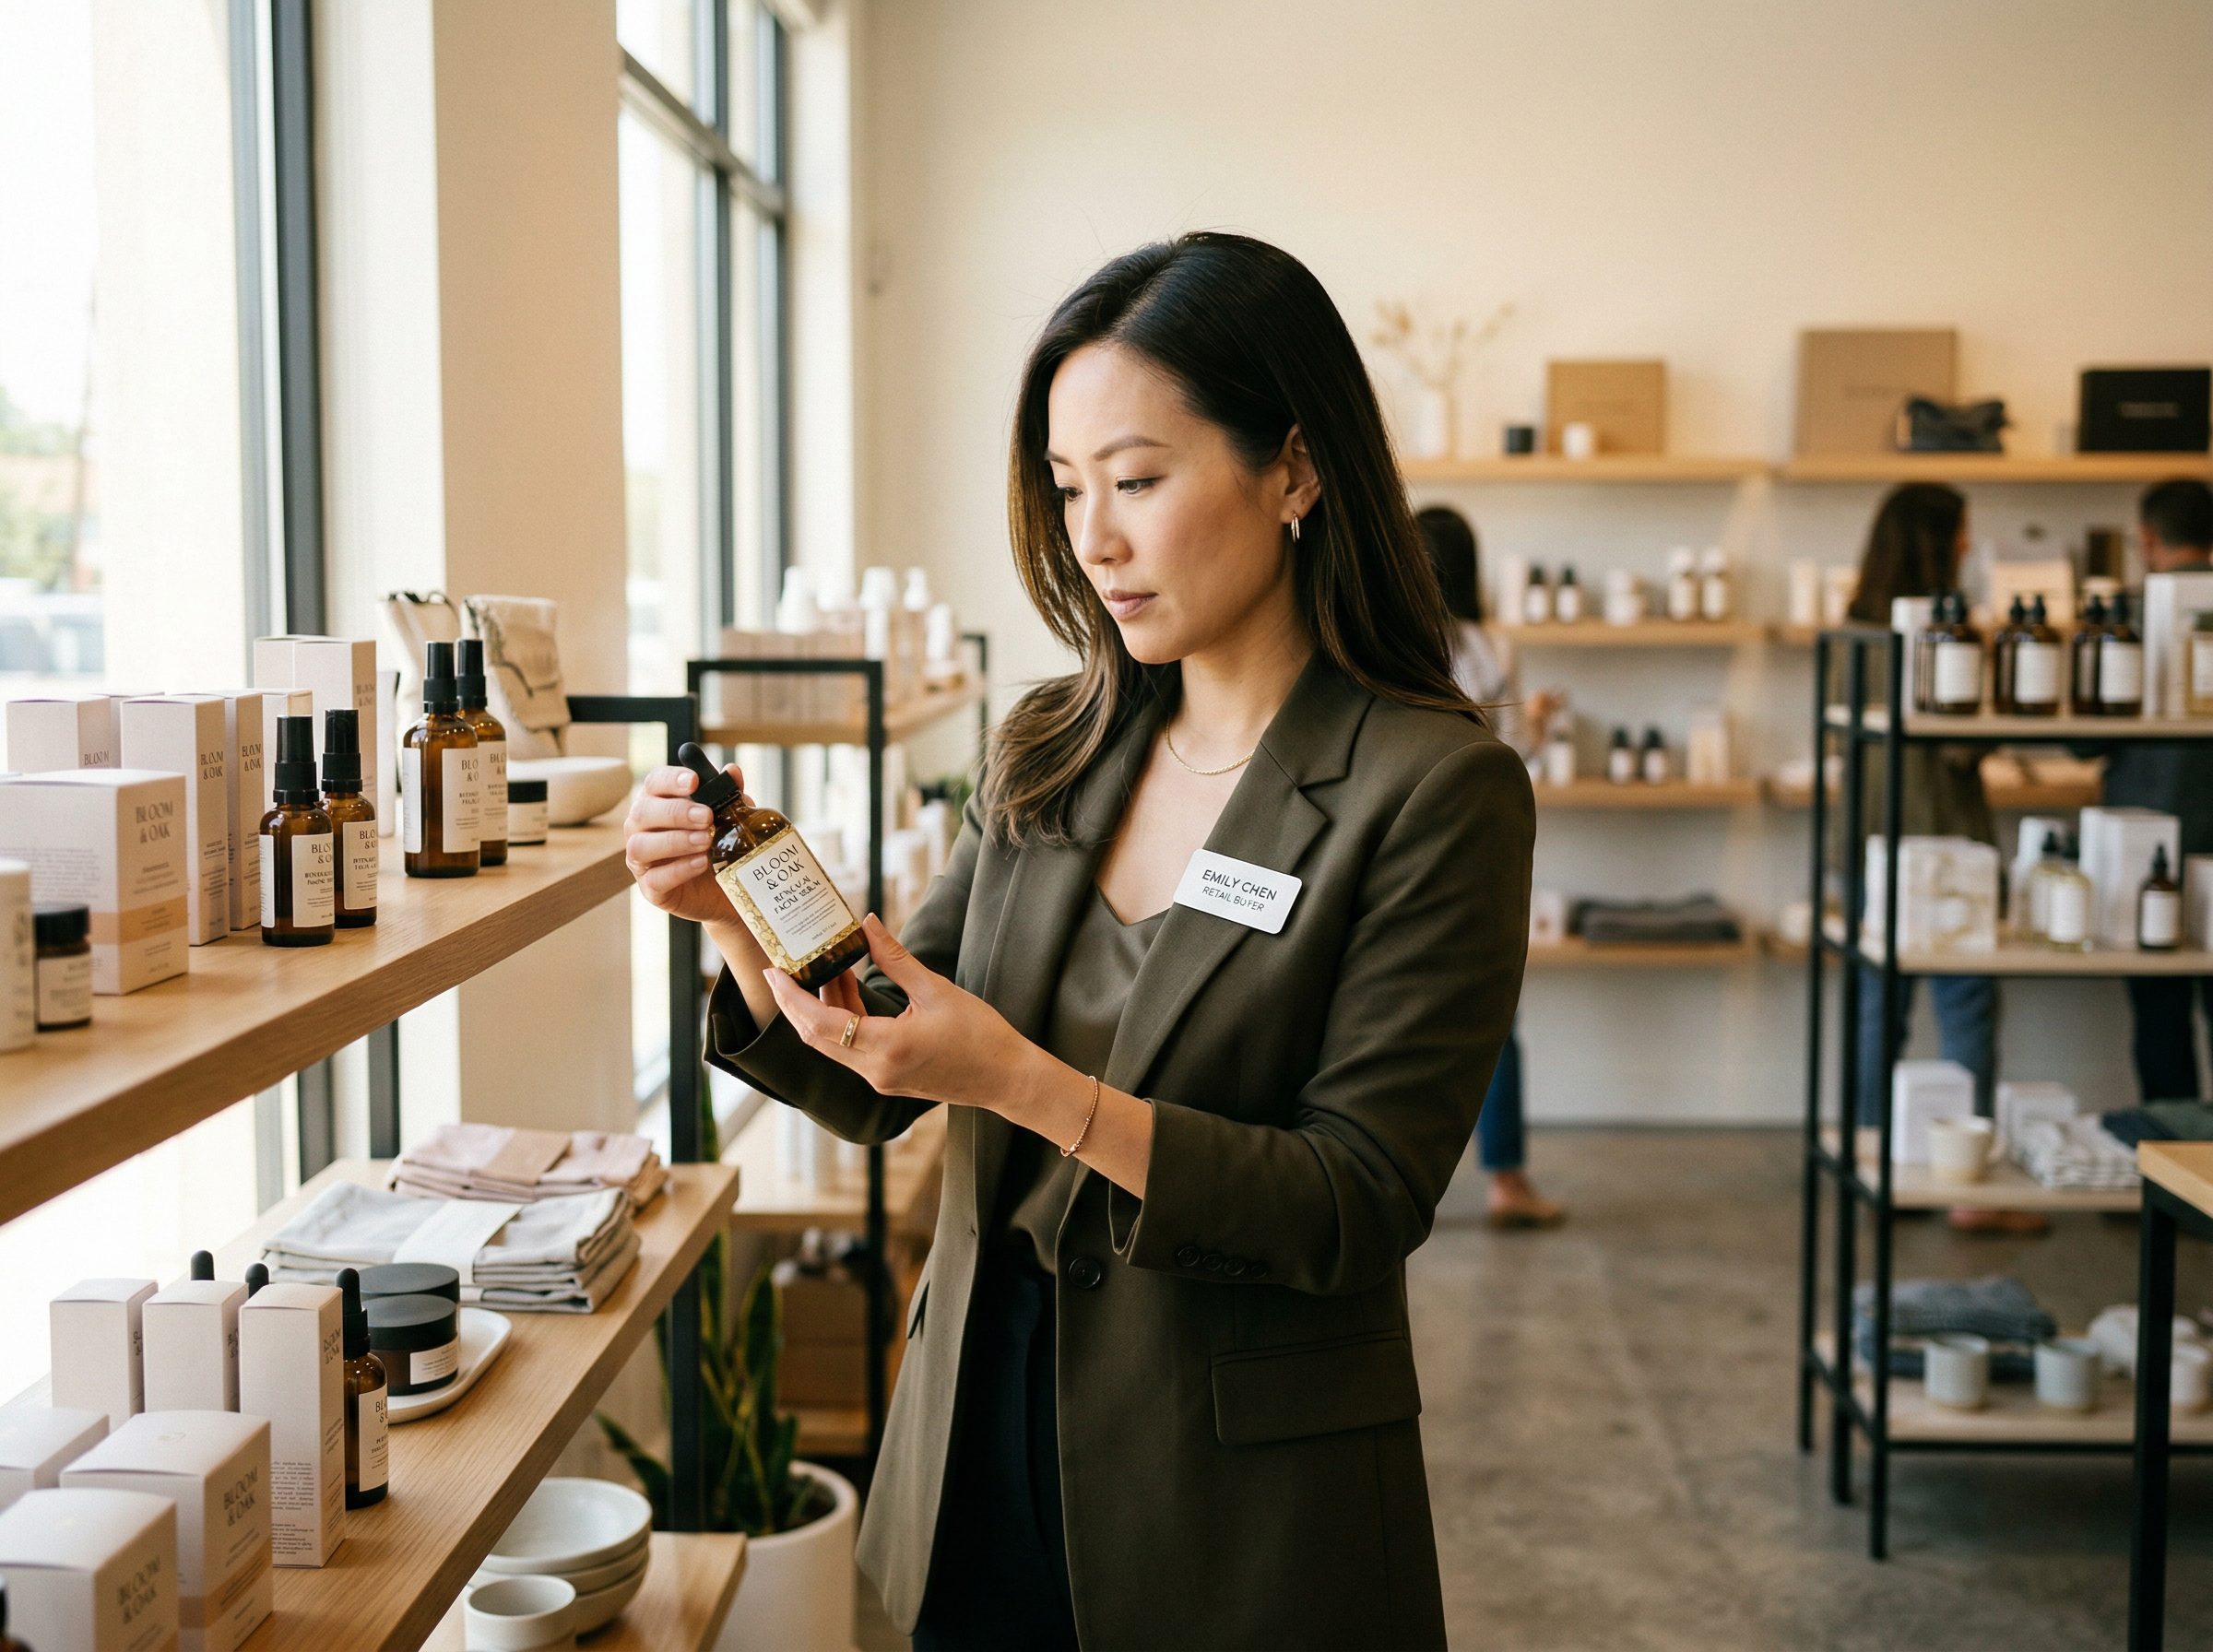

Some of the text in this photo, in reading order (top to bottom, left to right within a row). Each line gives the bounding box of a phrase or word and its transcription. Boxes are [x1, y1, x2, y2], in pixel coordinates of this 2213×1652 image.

[752, 844, 799, 881] BLOOM
[766, 858, 805, 890] & OAK
[1201, 869, 1278, 901] EMILY CHEN
[1202, 886, 1232, 903] RETAIL
